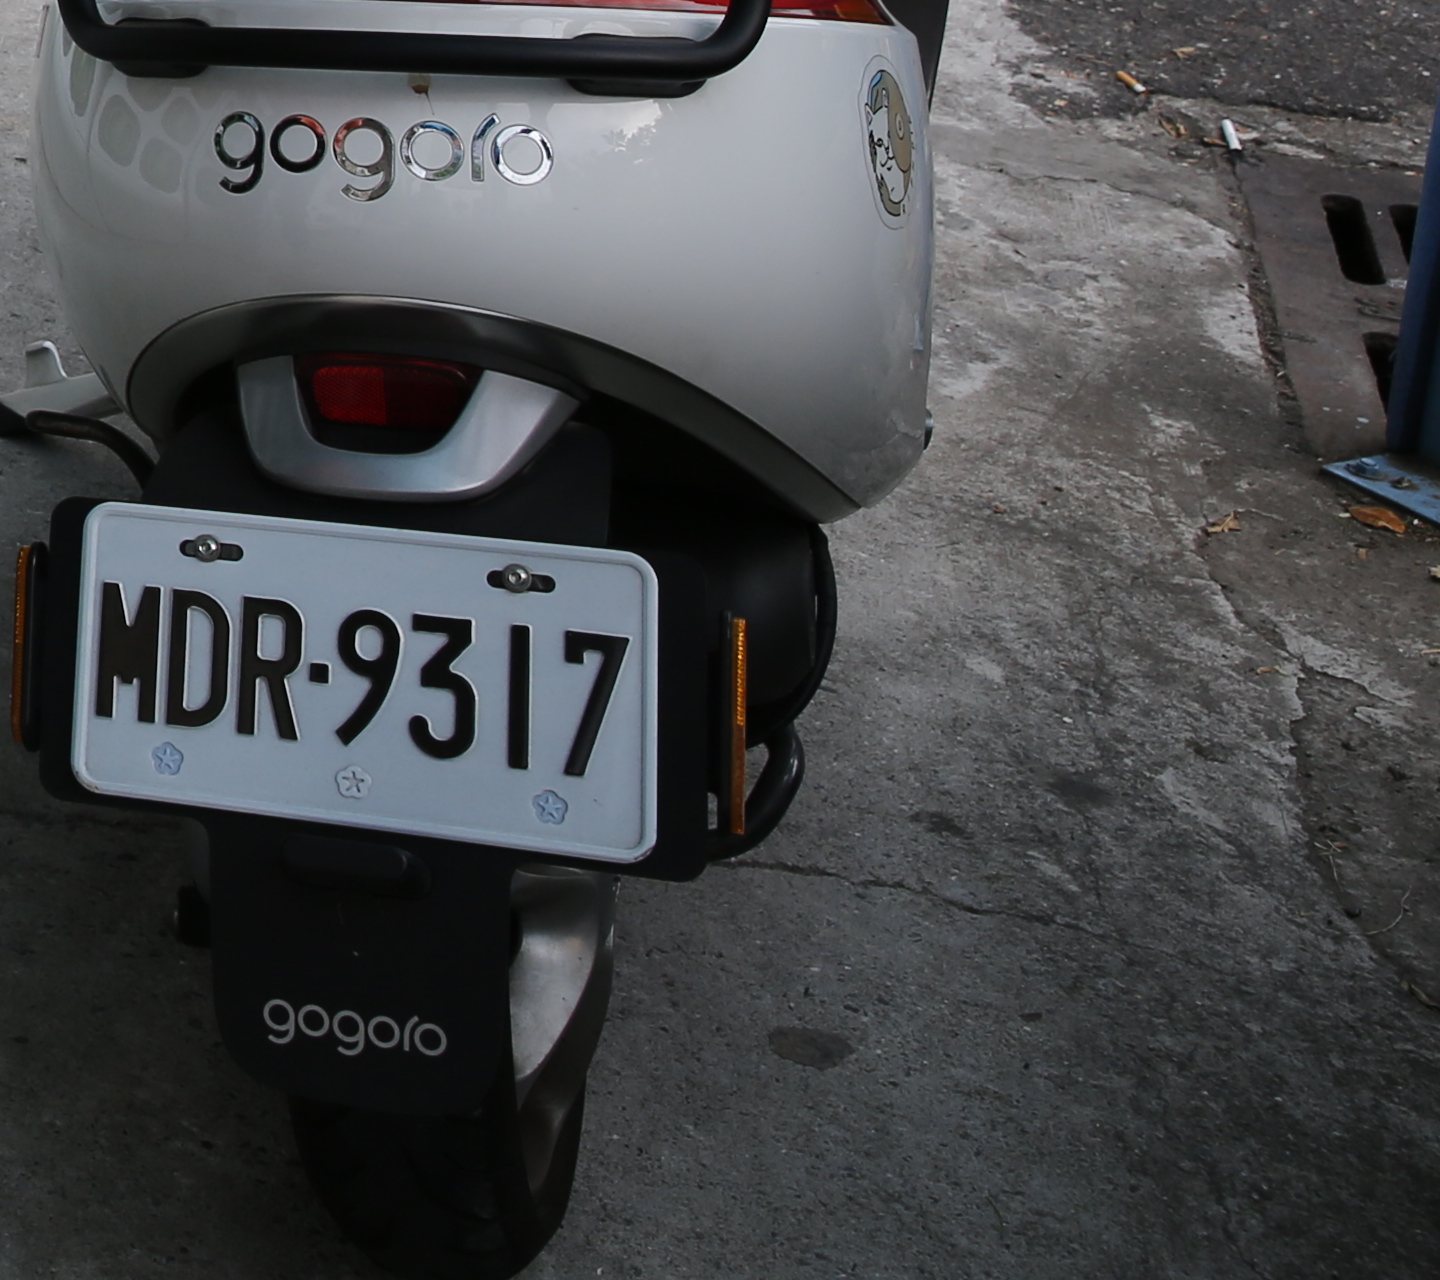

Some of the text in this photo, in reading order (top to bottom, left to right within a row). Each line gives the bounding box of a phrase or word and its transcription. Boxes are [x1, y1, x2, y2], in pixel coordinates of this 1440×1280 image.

[213, 112, 554, 202] gogoro
[94, 580, 631, 778] MDR-9317
[262, 999, 448, 1056] gogoro
